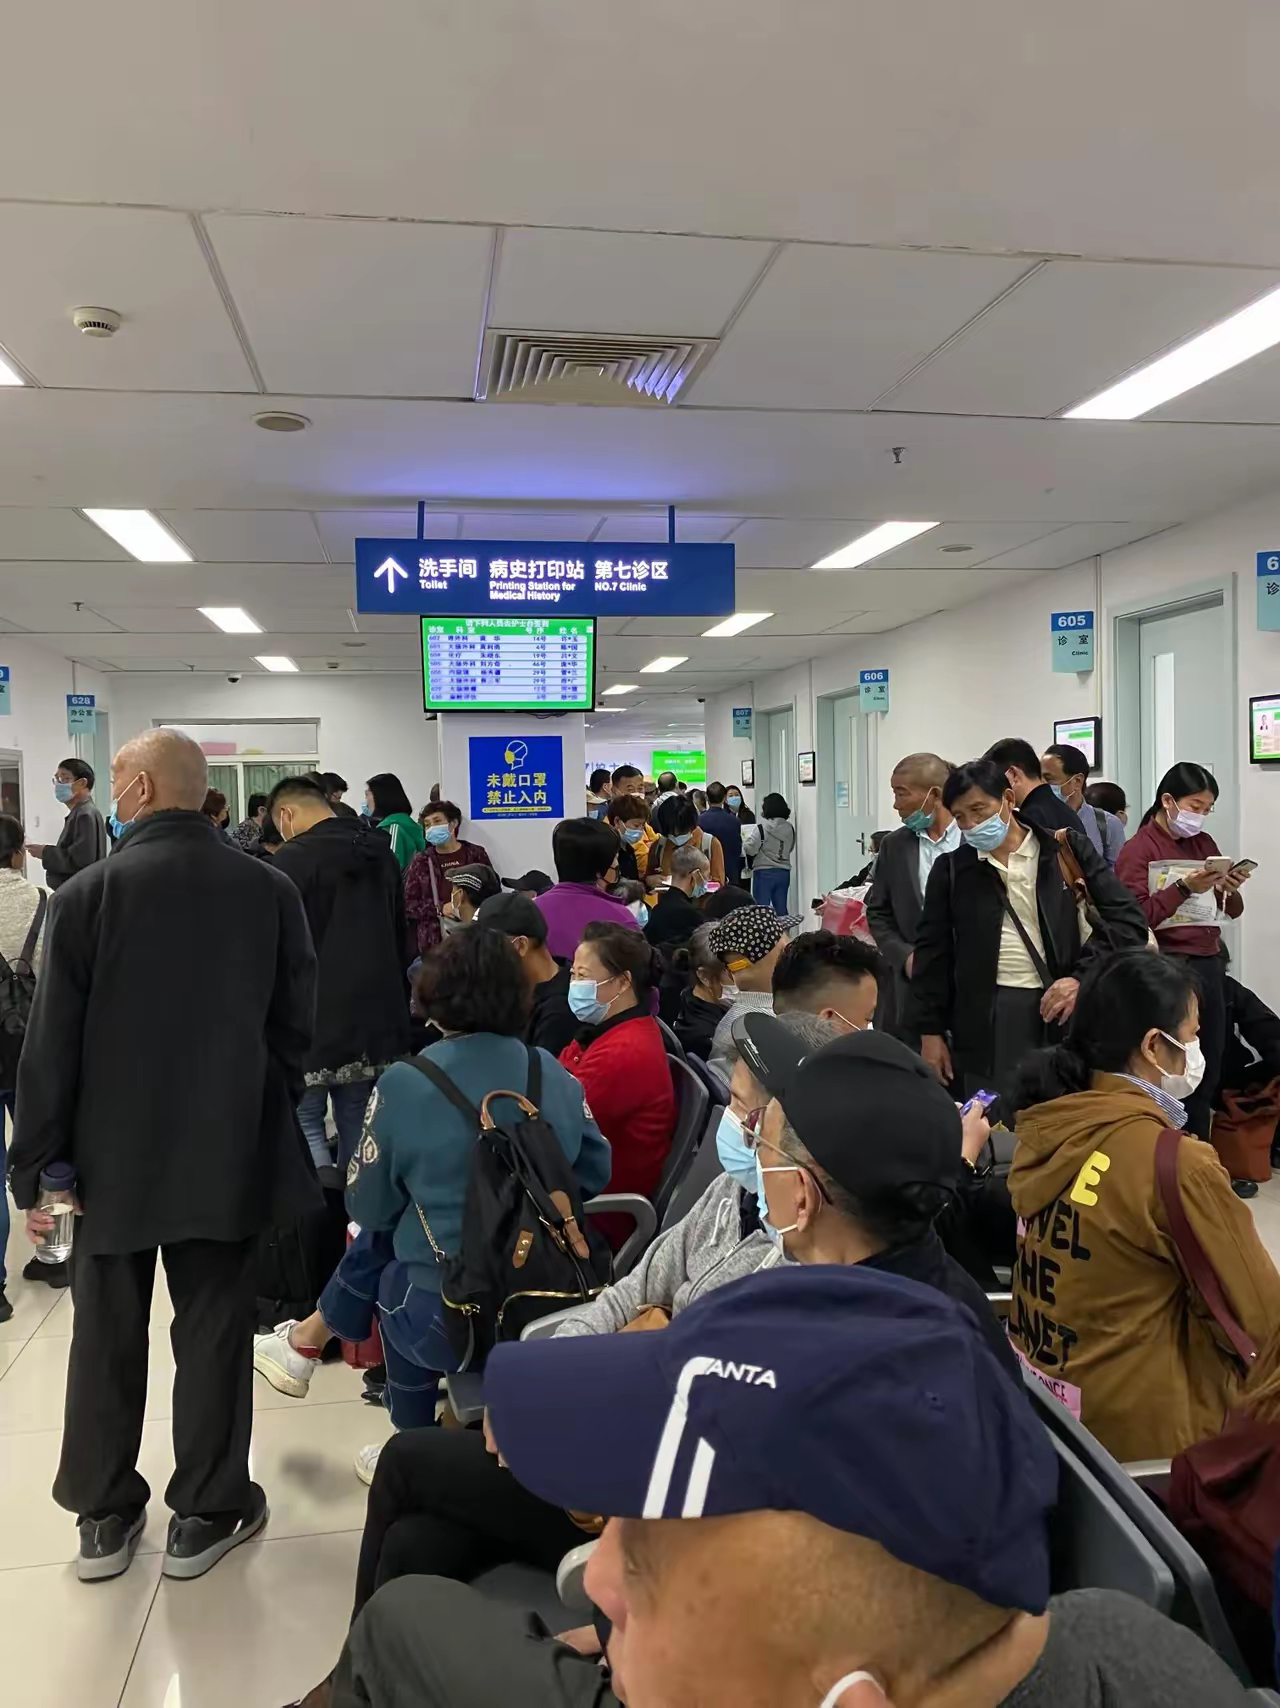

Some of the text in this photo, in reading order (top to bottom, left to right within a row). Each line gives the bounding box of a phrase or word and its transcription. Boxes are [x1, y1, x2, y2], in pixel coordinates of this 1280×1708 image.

[419, 558, 669, 580] 洗手间 病史打印站 第七诊区
[419, 580, 448, 589] Toilet
[489, 581, 576, 593] Printing Station for
[594, 582, 647, 591] NO.7 Clinic
[489, 591, 561, 602] Medical History
[1057, 615, 1087, 627] 605
[864, 672, 884, 681] 606
[71, 696, 91, 705] 628
[486, 772, 547, 788] 未戴口罩
[487, 789, 547, 805] 禁止入内
[705, 1358, 776, 1389] ANTA
